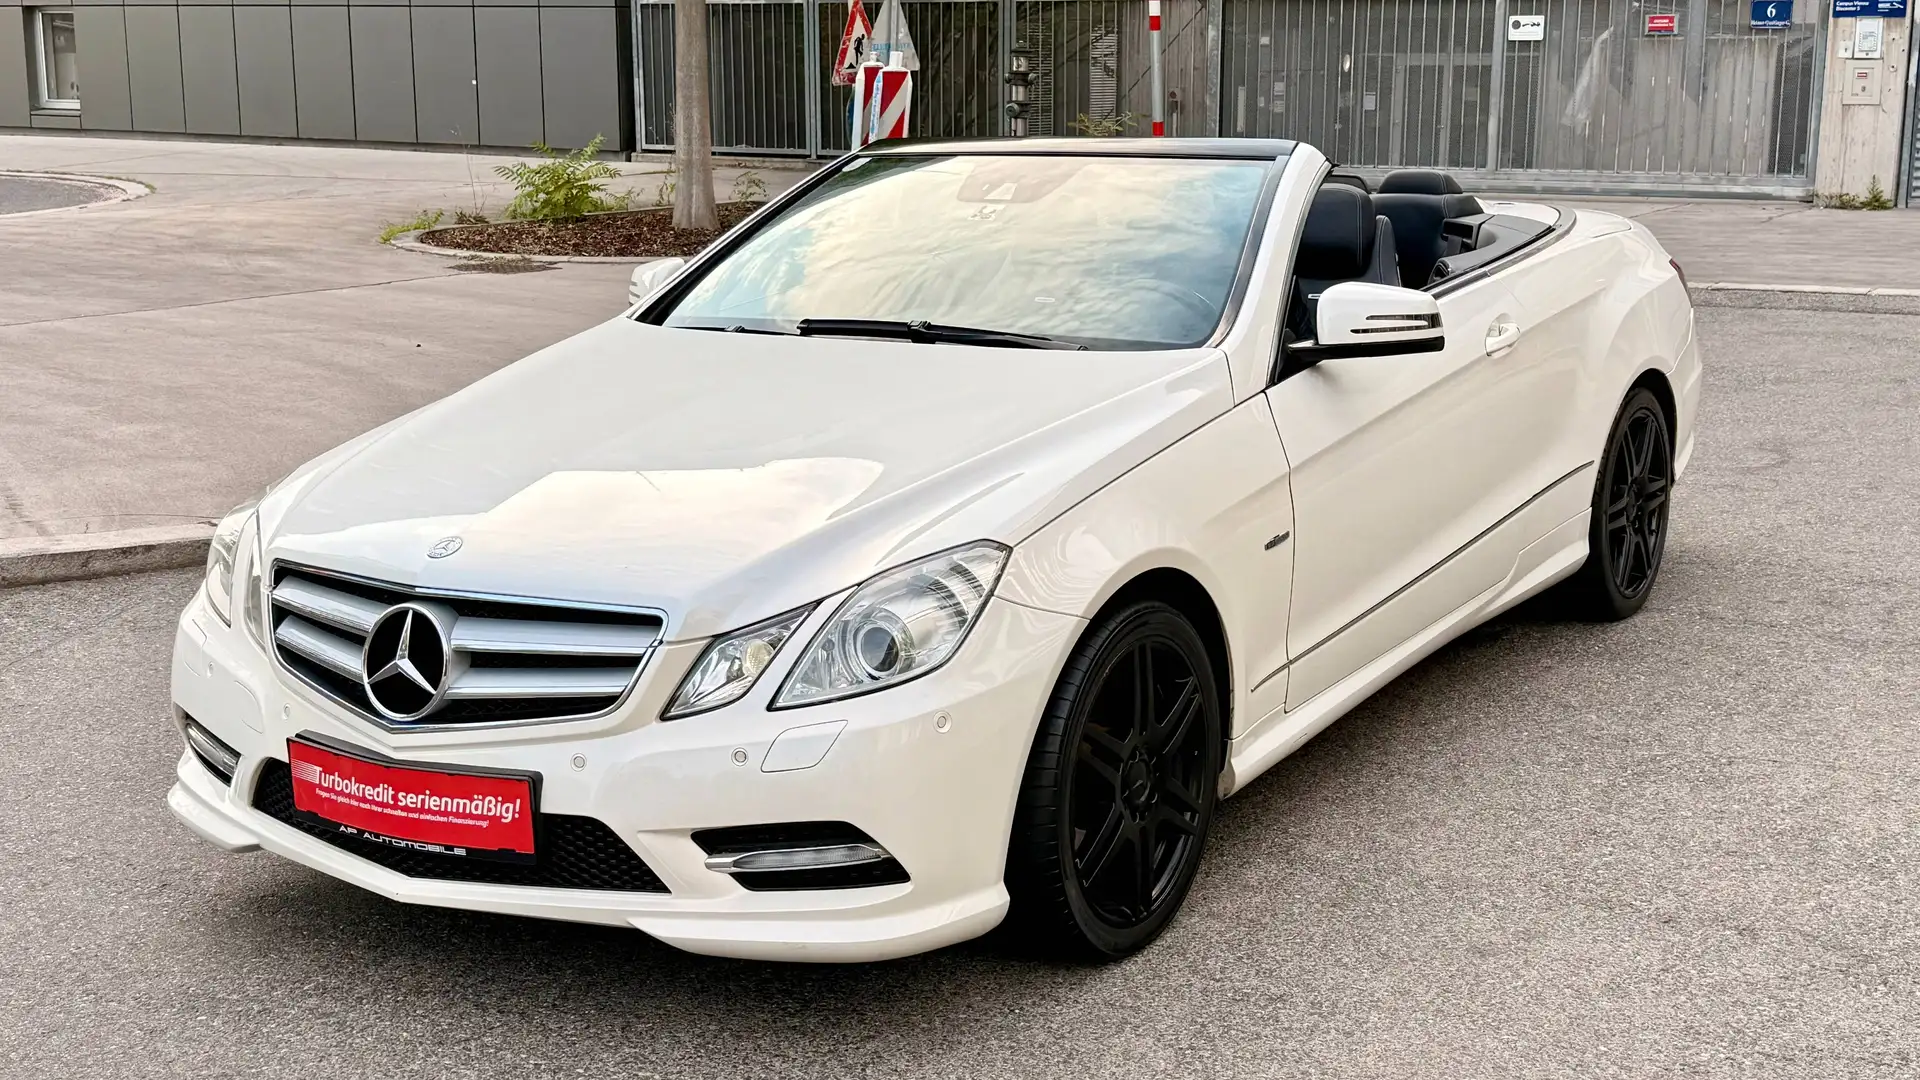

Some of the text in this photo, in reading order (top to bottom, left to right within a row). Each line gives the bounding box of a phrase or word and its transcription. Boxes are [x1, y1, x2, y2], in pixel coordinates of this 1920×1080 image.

[1767, 2, 1777, 18] 6
[314, 766, 521, 823] Turbokredit serienmäßig!
[315, 788, 330, 798] Fragen
[419, 813, 448, 822] einfachen
[448, 815, 489, 828] Finanzierung!
[339, 825, 467, 856] AP AUTOMOBILE
